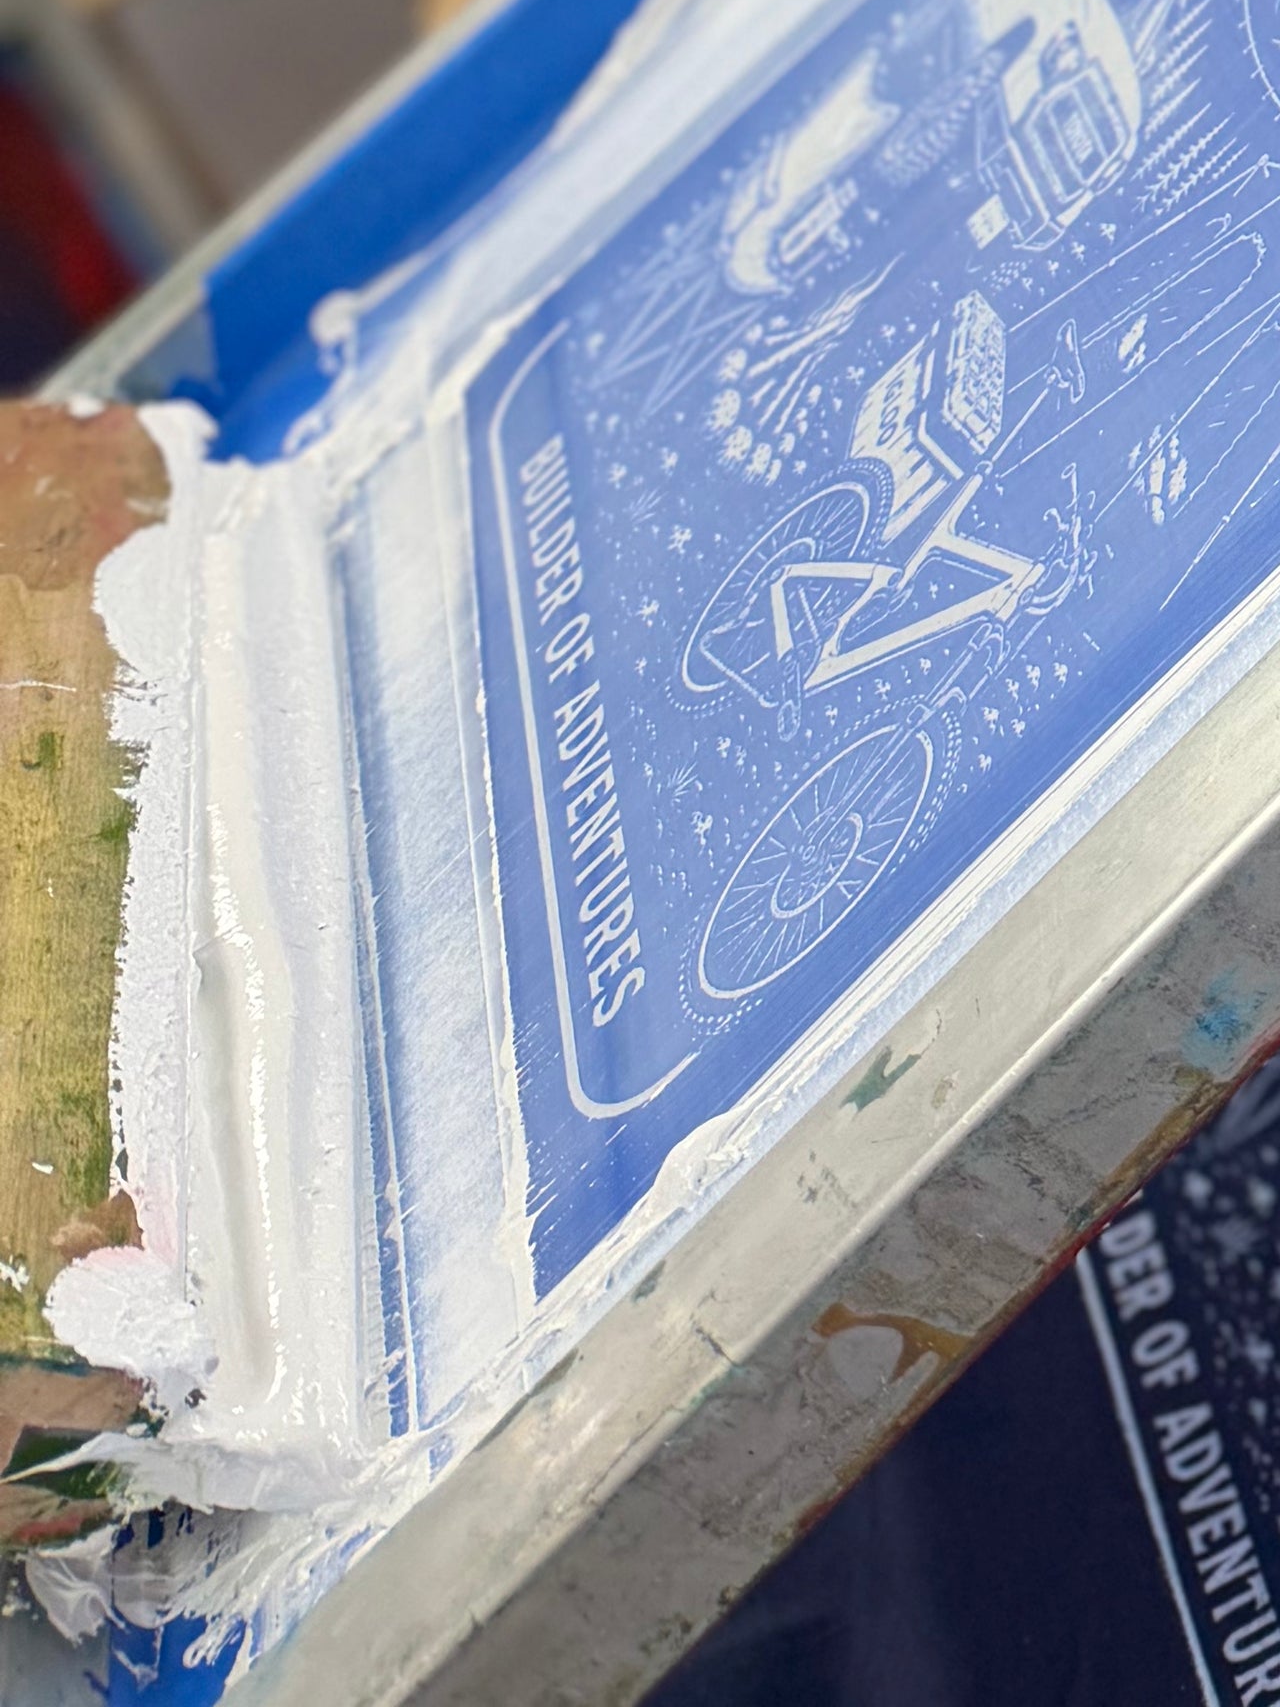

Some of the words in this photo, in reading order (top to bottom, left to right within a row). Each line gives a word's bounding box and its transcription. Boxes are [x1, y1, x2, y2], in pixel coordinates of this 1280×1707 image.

[520, 433, 584, 626] BUILDER
[545, 612, 595, 684] OF
[554, 679, 646, 1028] ADVENTURES
[1132, 1319, 1199, 1390] OF
